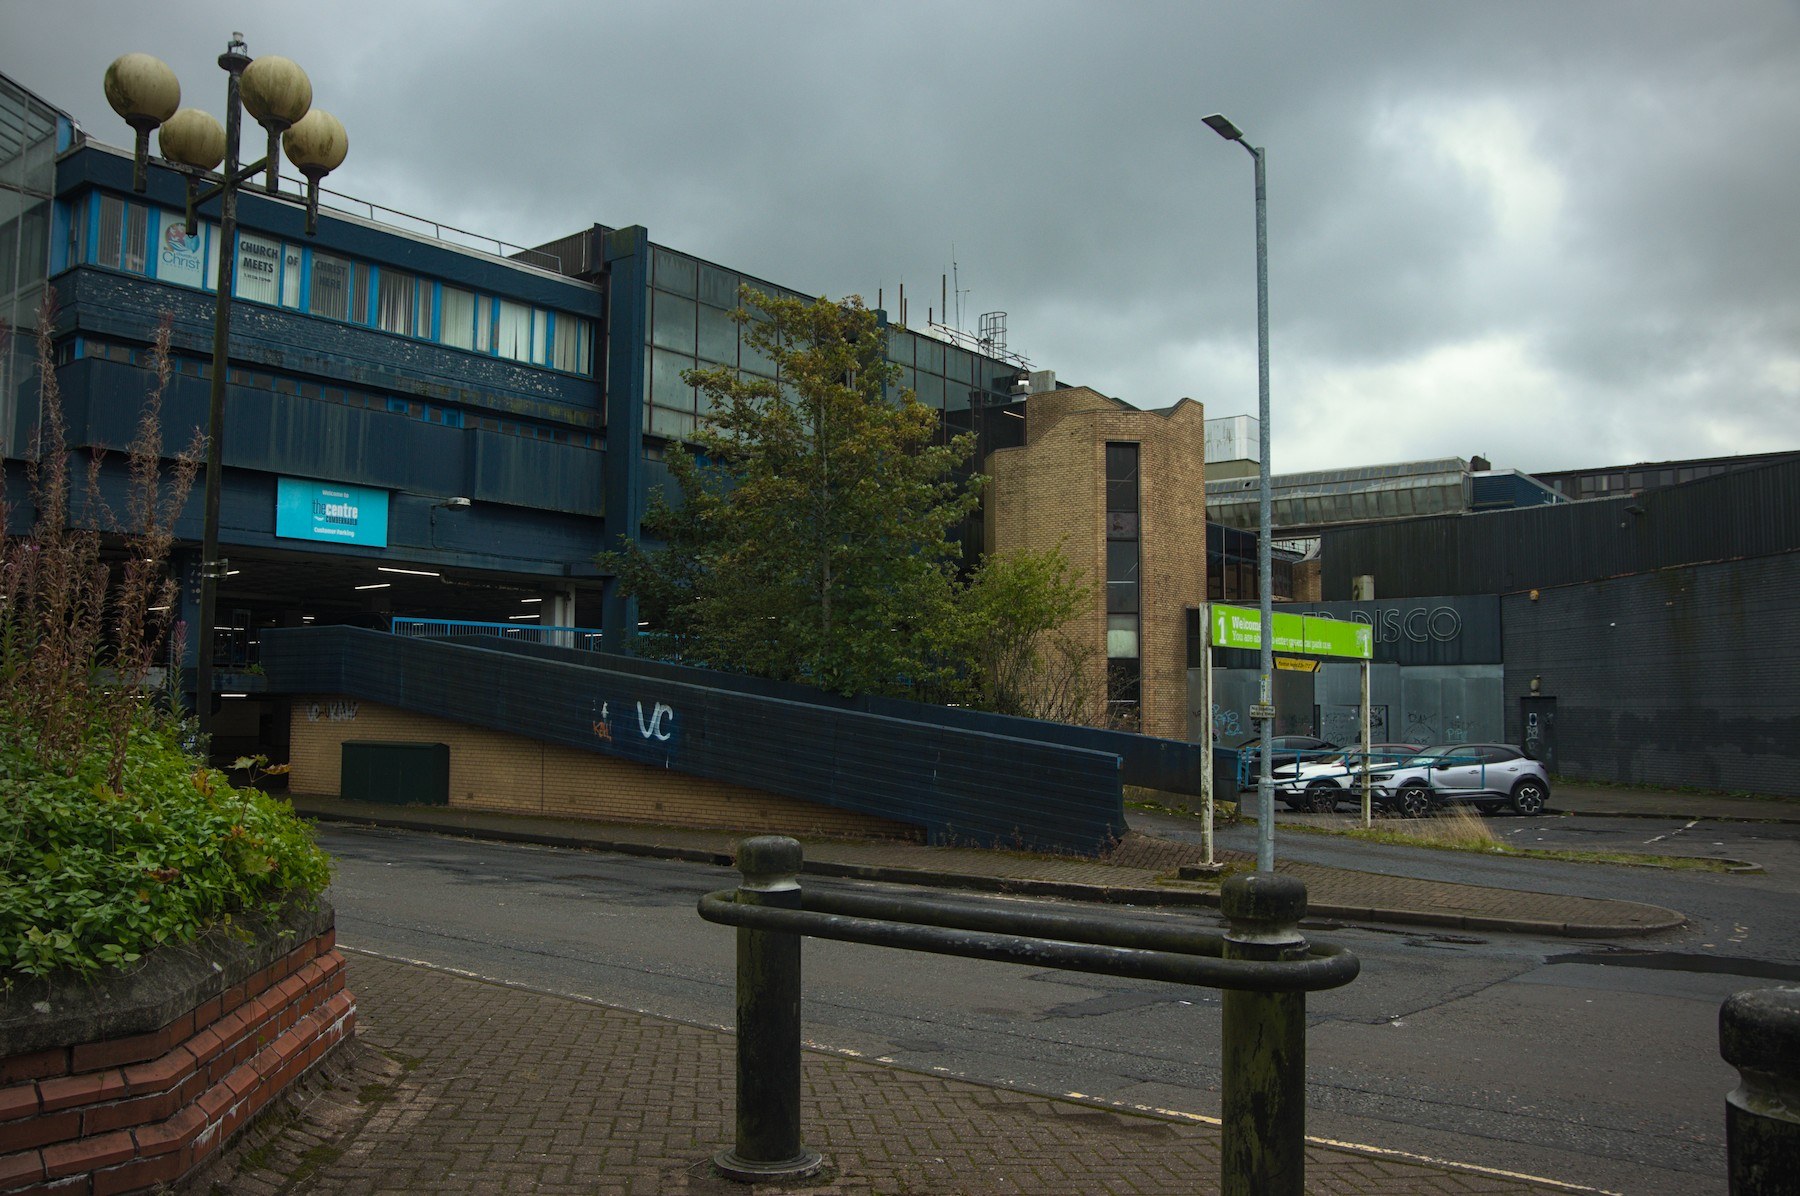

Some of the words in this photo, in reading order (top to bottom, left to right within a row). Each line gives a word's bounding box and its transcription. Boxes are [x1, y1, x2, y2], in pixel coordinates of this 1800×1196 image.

[162, 251, 200, 269] Christ
[240, 241, 278, 259] CHURCH
[287, 254, 299, 266] OF
[315, 260, 347, 276] CHRIST
[243, 257, 273, 273] MEETS
[319, 275, 341, 289] HERE
[322, 490, 343, 498] Welcome
[314, 527, 336, 536] Customer
[1218, 616, 1227, 645] 1
[1232, 630, 1243, 641] You
